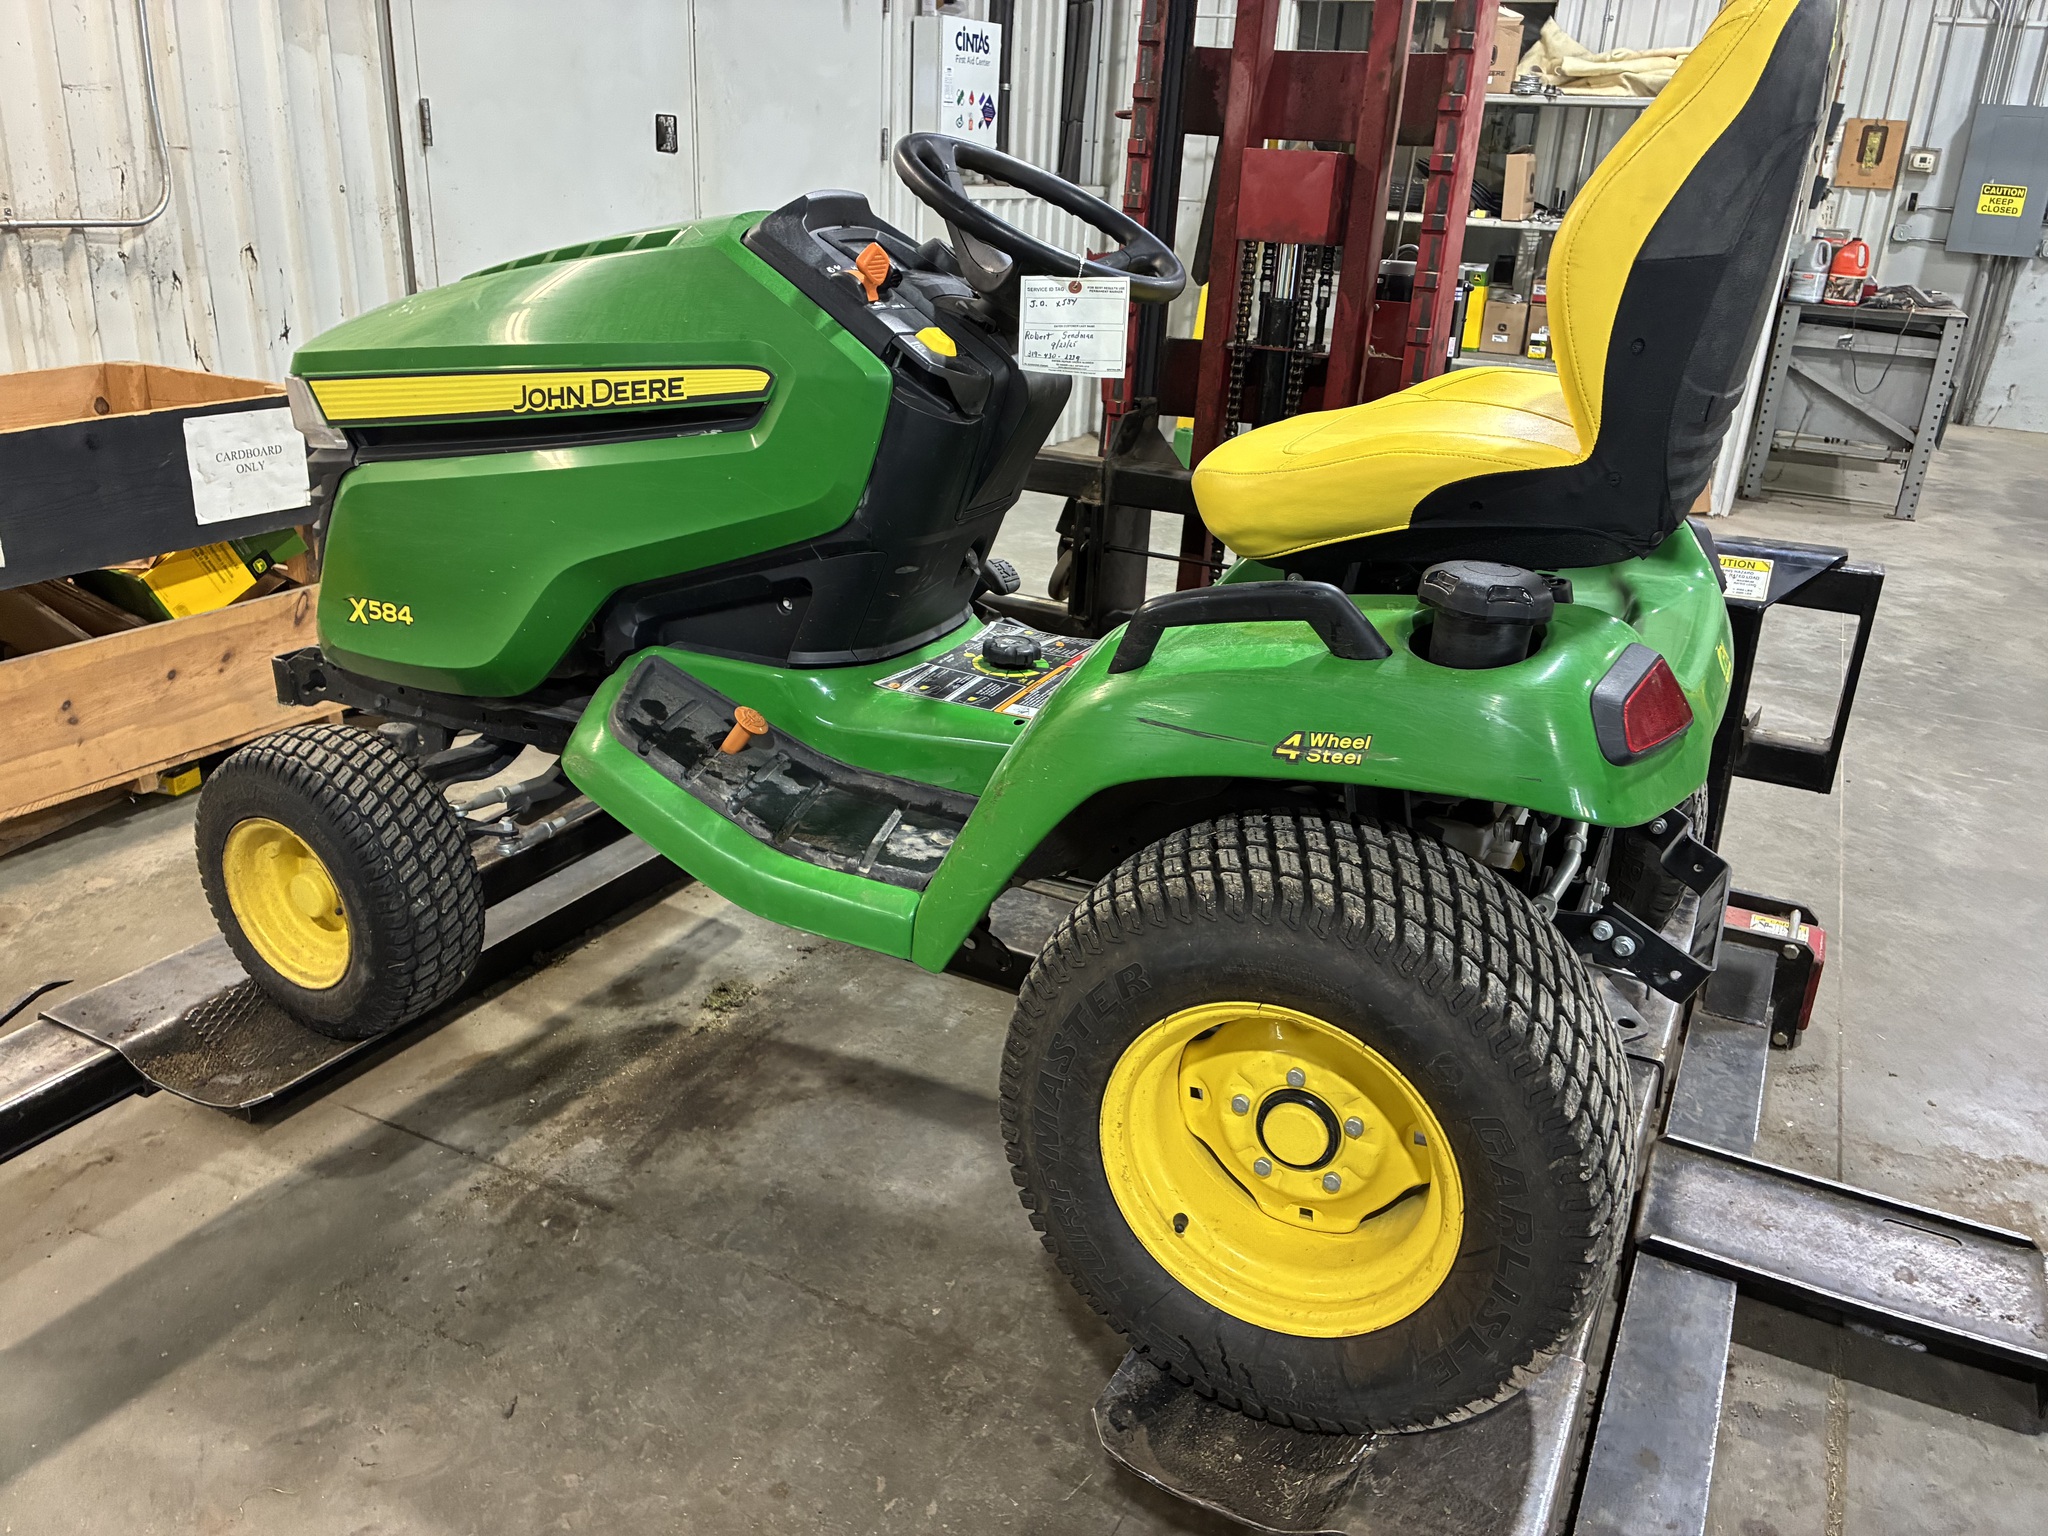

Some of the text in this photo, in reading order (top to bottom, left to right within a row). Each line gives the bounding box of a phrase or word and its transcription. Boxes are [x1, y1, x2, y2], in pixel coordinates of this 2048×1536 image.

[955, 26, 990, 54] CINTAS
[967, 56, 975, 65] Aid
[1983, 186, 2025, 197] CAUTION
[1989, 197, 2014, 205] KEEP
[1981, 205, 2018, 214] CLOSED
[1025, 330, 1054, 340] Robert
[513, 377, 685, 409] JOHN DEERE
[216, 445, 282, 462] CARDBOARD
[236, 460, 264, 473] ONLY
[1719, 558, 1756, 569] UTION
[346, 597, 414, 625] X584
[1274, 732, 1372, 762] 4 Wheel
[1419, 1117, 1534, 1389] CARLISLE
